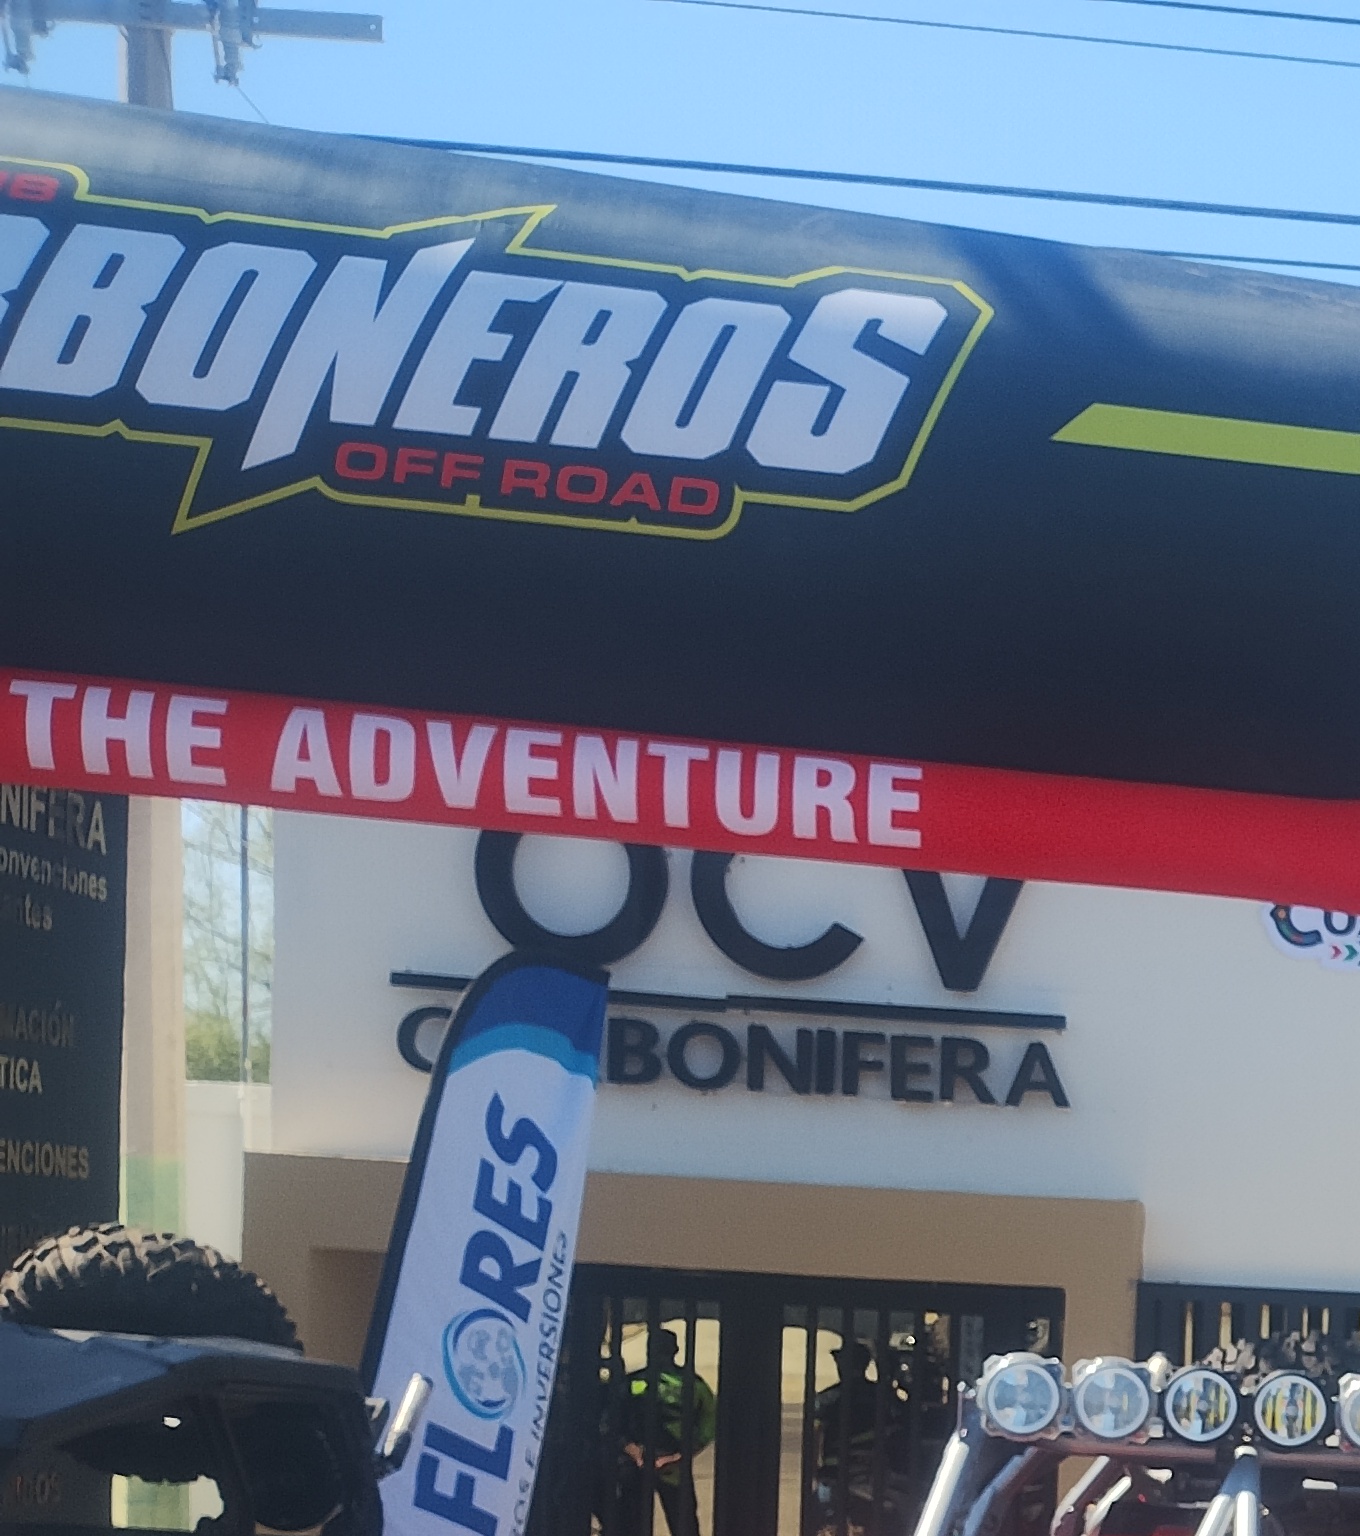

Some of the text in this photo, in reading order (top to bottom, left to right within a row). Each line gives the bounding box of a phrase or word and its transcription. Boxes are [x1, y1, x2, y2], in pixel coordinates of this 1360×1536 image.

[334, 441, 721, 518] OFF ROAD
[9, 677, 924, 850] THE ADVENTURE
[397, 1006, 1071, 1108] CBONIFERA
